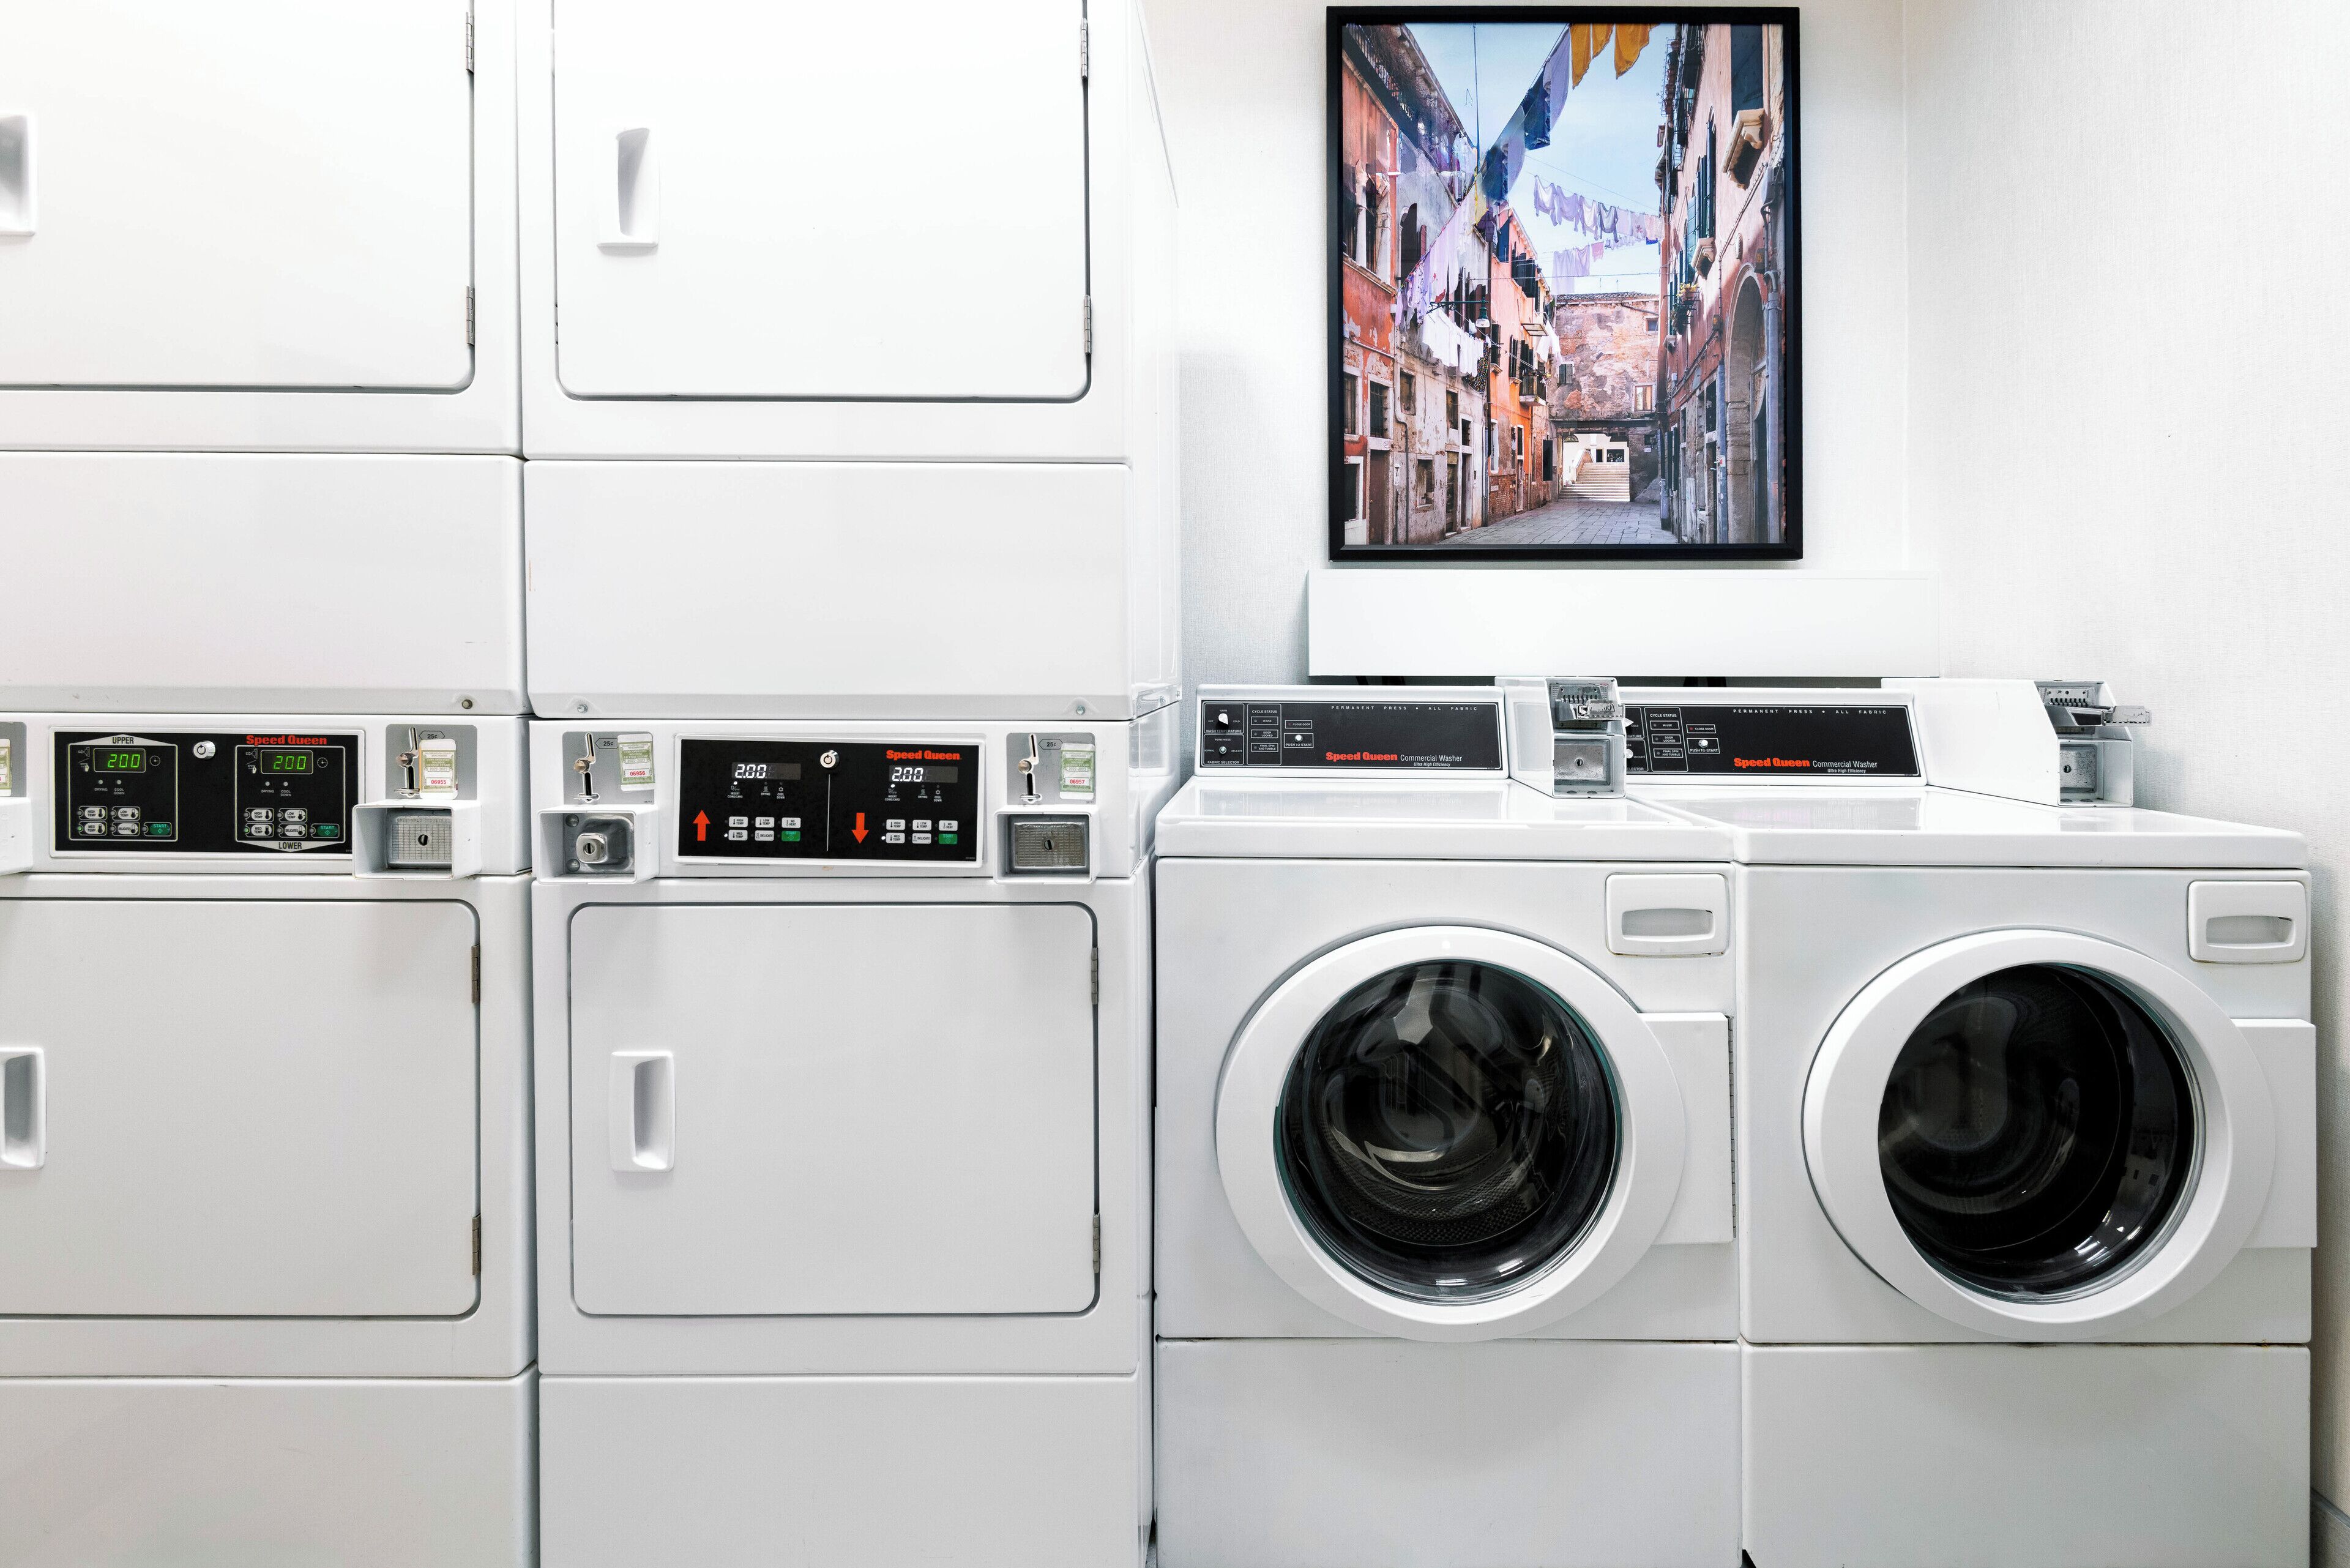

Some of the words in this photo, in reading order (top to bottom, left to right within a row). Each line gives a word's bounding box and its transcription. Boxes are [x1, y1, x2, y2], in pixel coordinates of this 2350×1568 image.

[246, 735, 285, 746] Speed
[288, 735, 327, 744] Queen
[108, 754, 140, 767] 200
[886, 750, 922, 761] Speed
[924, 750, 960, 760] Queen
[1326, 752, 1360, 761] Speed
[1362, 752, 1398, 760] Queen
[274, 756, 306, 769] 200
[1734, 758, 1771, 768] Speed
[1772, 758, 1810, 767] Queen
[735, 764, 767, 778] 2.00
[892, 767, 923, 782] 2.00
